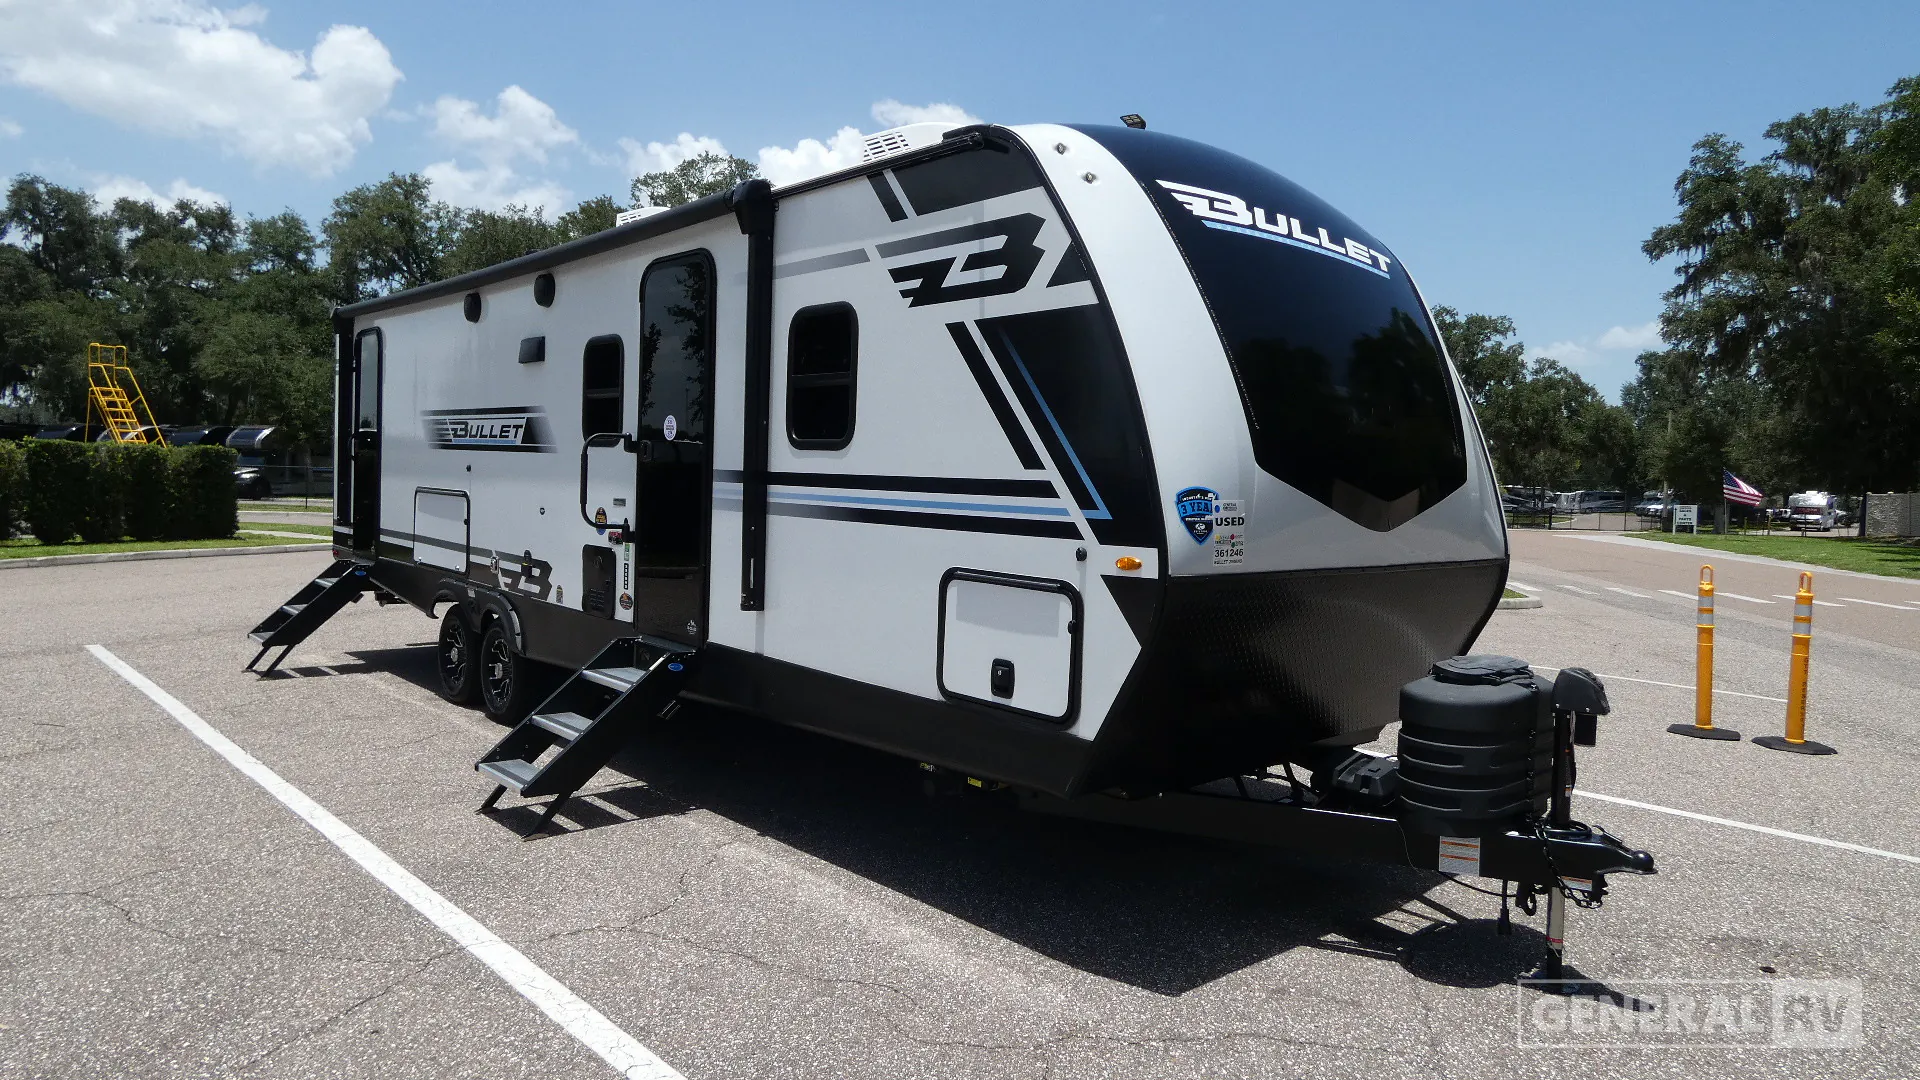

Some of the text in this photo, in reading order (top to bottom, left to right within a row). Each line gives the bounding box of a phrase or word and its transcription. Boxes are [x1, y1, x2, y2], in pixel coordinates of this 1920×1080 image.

[1155, 179, 1391, 272] BULLET
[450, 420, 524, 439] BULLET
[1181, 504, 1188, 515] 3
[1189, 501, 1213, 514] YEA
[1215, 517, 1245, 527] USED
[1214, 548, 1244, 558] 361246
